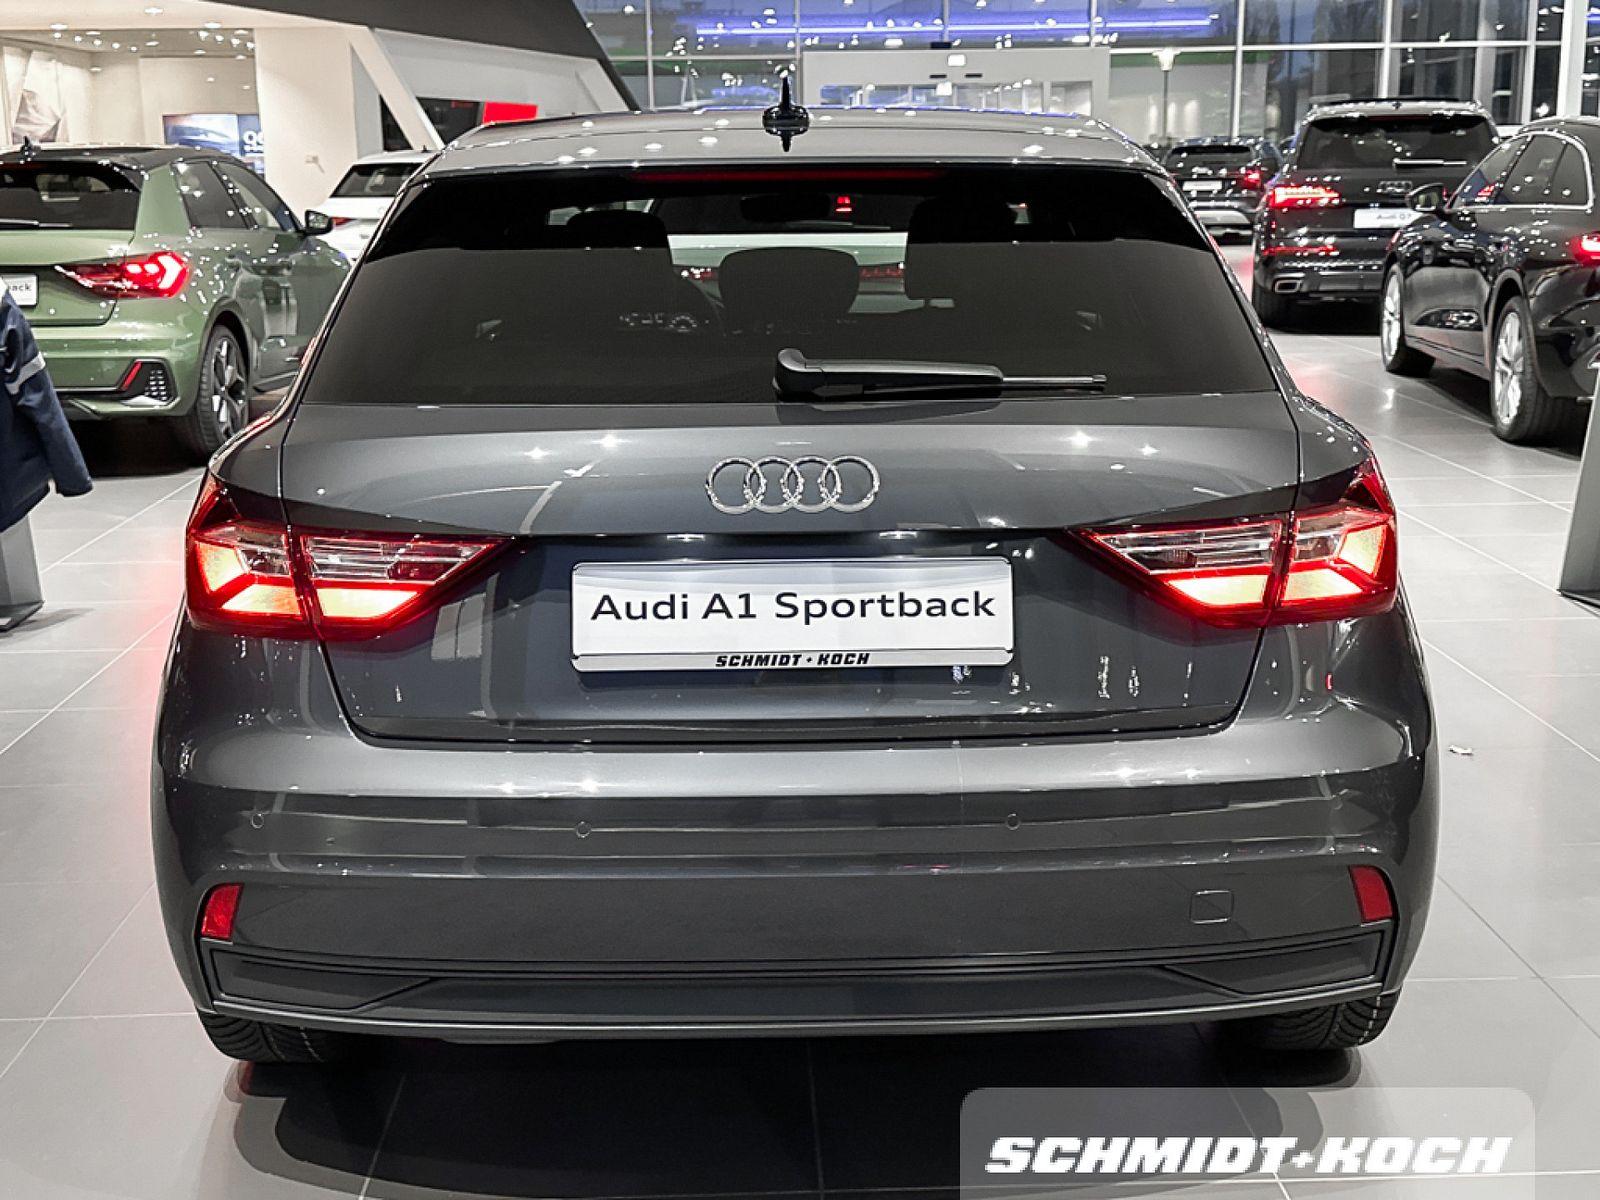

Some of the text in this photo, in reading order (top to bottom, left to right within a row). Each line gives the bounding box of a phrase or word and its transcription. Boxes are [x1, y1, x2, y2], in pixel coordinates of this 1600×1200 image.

[590, 590, 996, 626] Audi A1 Sportback
[715, 654, 803, 668] SCHMIDT
[817, 652, 871, 665] KOCH
